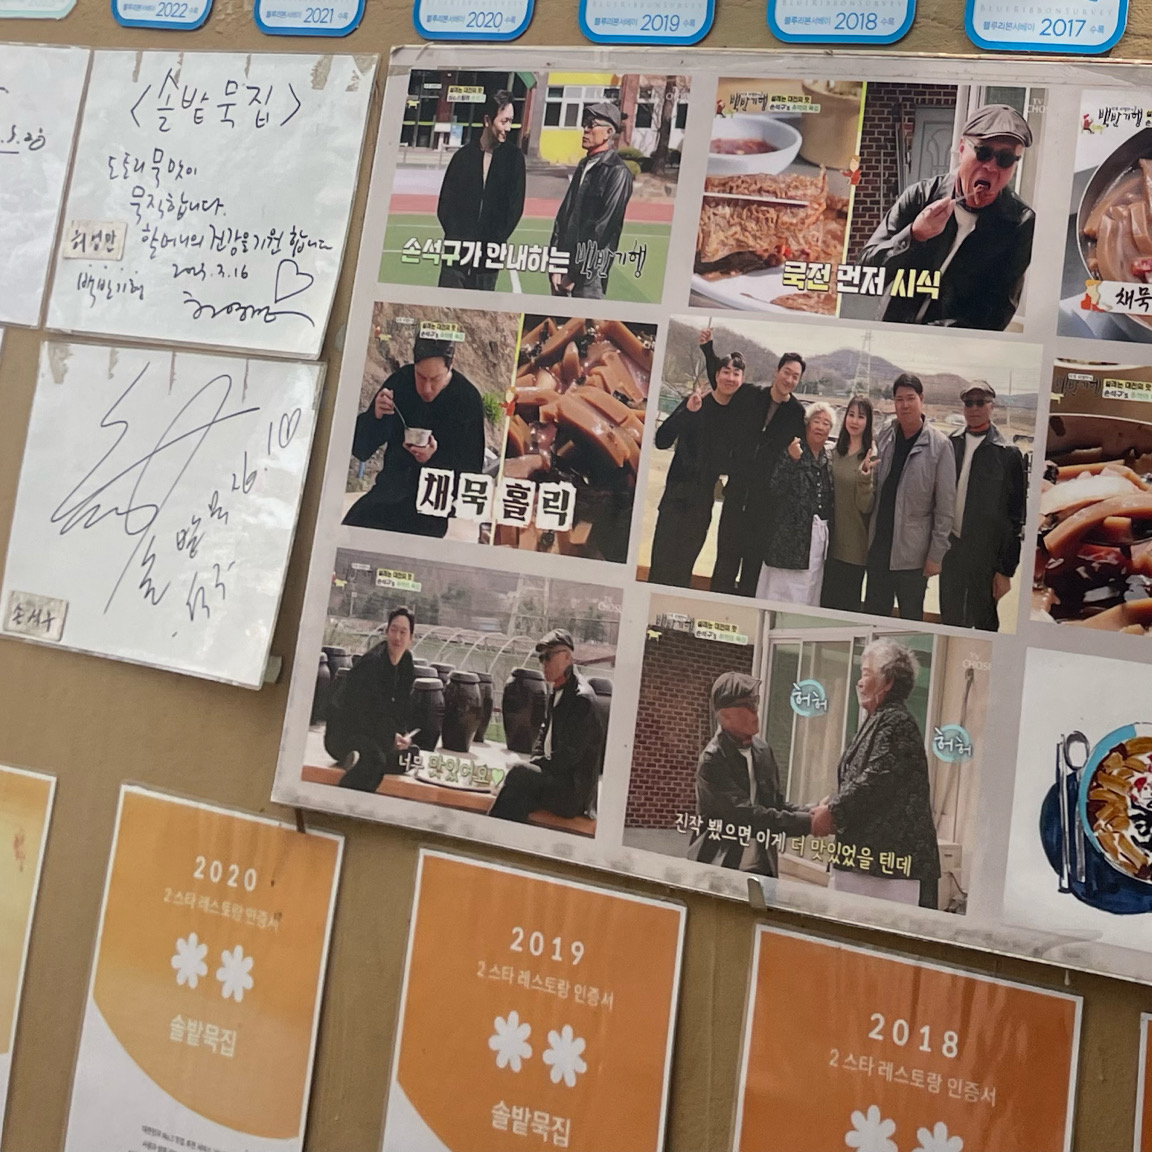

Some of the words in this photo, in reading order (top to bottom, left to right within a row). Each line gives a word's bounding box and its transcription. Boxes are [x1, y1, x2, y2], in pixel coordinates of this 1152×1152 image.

[155, 1, 189, 18] 2022
[303, 8, 334, 24] 2021
[466, 11, 504, 29] 2020
[640, 14, 681, 32] 2019
[784, 16, 831, 26] 블루리본서베이
[834, 12, 878, 31] 2018
[983, 20, 1035, 32] 블루리본서베이
[1039, 18, 1087, 38] 2017
[1089, 24, 1105, 35] 수록
[401, 237, 482, 268] 손석구가
[485, 242, 571, 275] 안내하는
[782, 260, 832, 291] 묵전
[837, 263, 886, 296] 먼저
[890, 268, 941, 300] 시식
[503, 483, 570, 526] 홀릭
[399, 752, 425, 778] 너무
[675, 813, 704, 837] 진작
[756, 828, 787, 853] 이게
[791, 835, 805, 857] 더
[811, 838, 874, 870] 맛있었을
[879, 852, 913, 877] 텐데
[193, 856, 257, 892] 2020
[510, 926, 585, 965] 2019
[517, 970, 571, 999] 레스토랑
[574, 983, 614, 1011] 인증서
[170, 1014, 237, 1057] 솔밭묵집
[868, 1013, 959, 1059] 2018
[877, 1061, 942, 1095] 레스토랑
[948, 1077, 997, 1107] 인증서
[491, 1100, 571, 1148] 솔밭묵집
